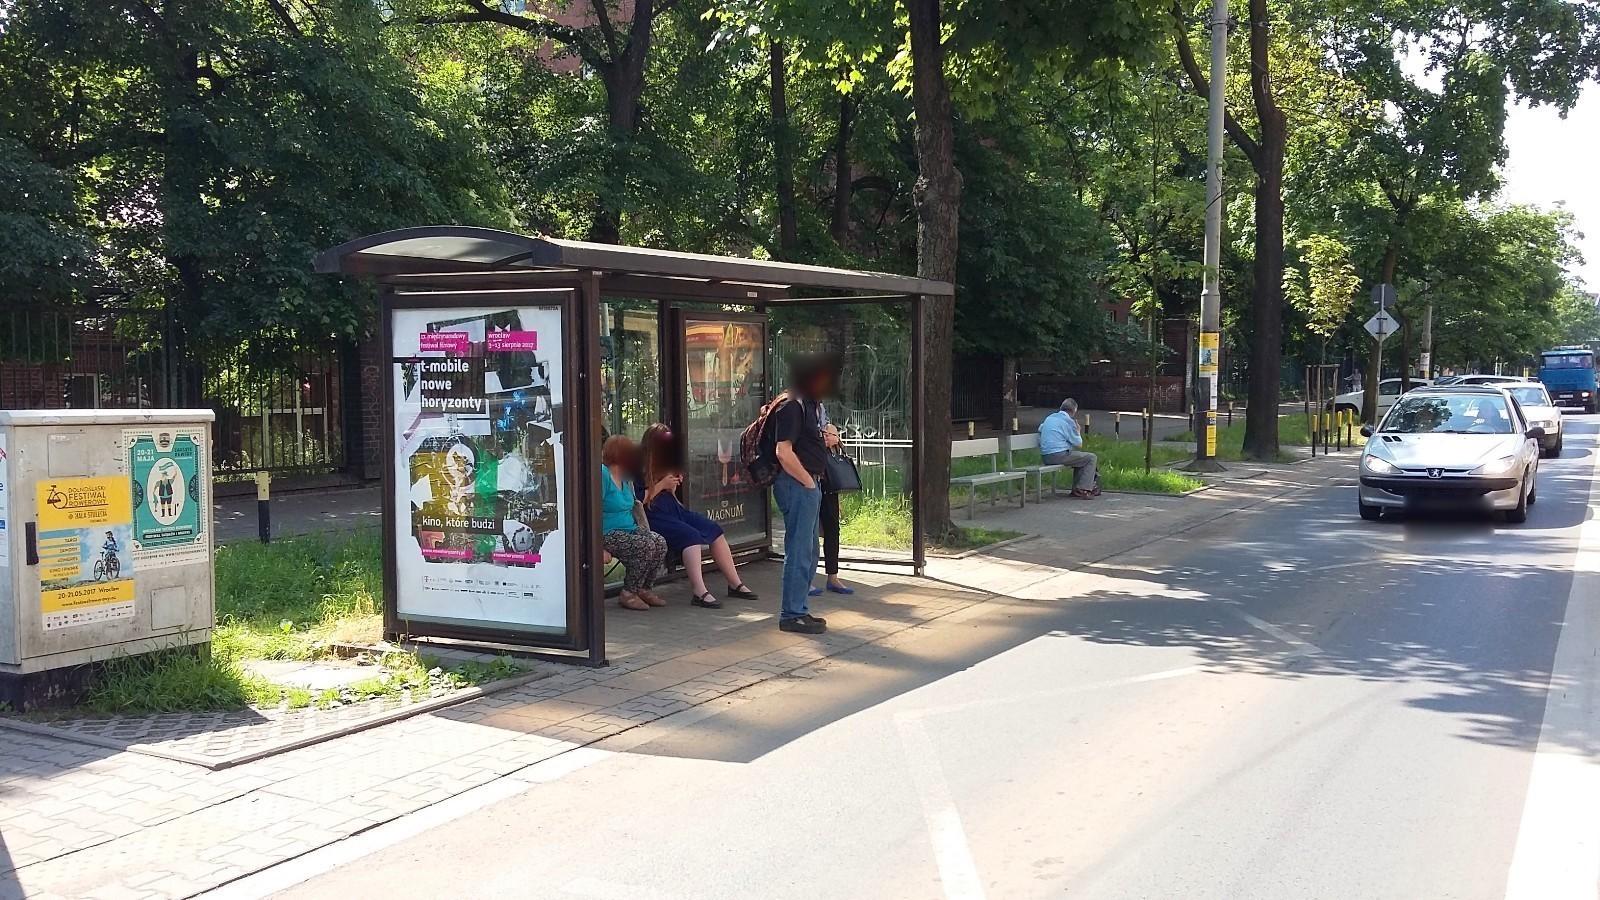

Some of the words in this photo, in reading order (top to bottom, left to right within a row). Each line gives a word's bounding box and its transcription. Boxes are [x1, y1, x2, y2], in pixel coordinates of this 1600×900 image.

[420, 359, 469, 373] t-mobile
[421, 380, 452, 390] nowe
[421, 395, 482, 412] horyzonty
[68, 491, 106, 501] FESTIWAL
[706, 503, 744, 521] MAGNUM
[422, 515, 443, 529] kino,
[445, 516, 469, 528] które
[471, 518, 495, 529] budzi
